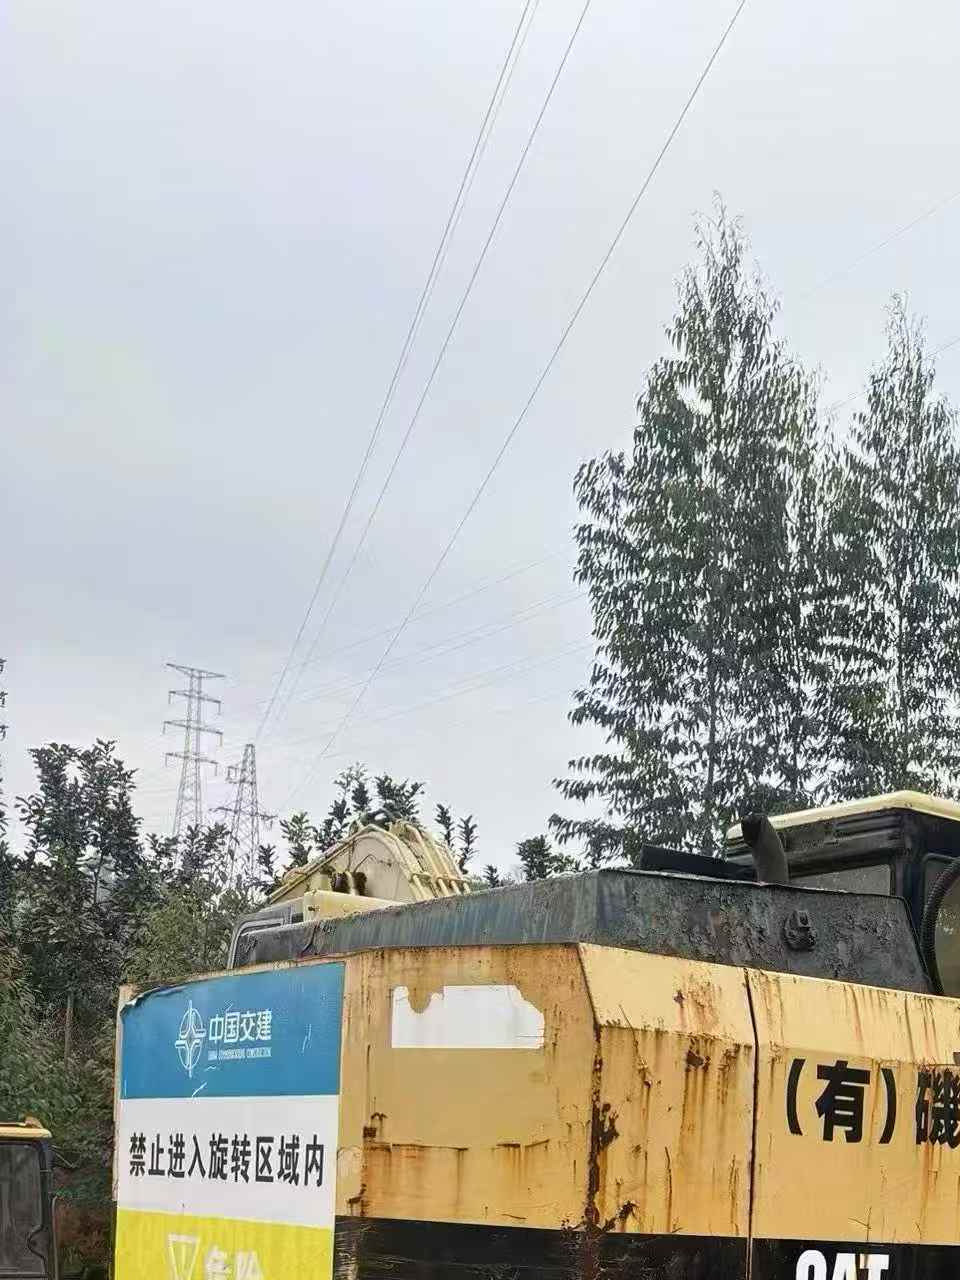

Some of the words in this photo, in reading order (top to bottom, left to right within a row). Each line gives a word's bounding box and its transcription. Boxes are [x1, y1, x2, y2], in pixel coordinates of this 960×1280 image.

[209, 1010, 272, 1044] 中国交建
[129, 1132, 325, 1188] 禁止进入旋转区域内
